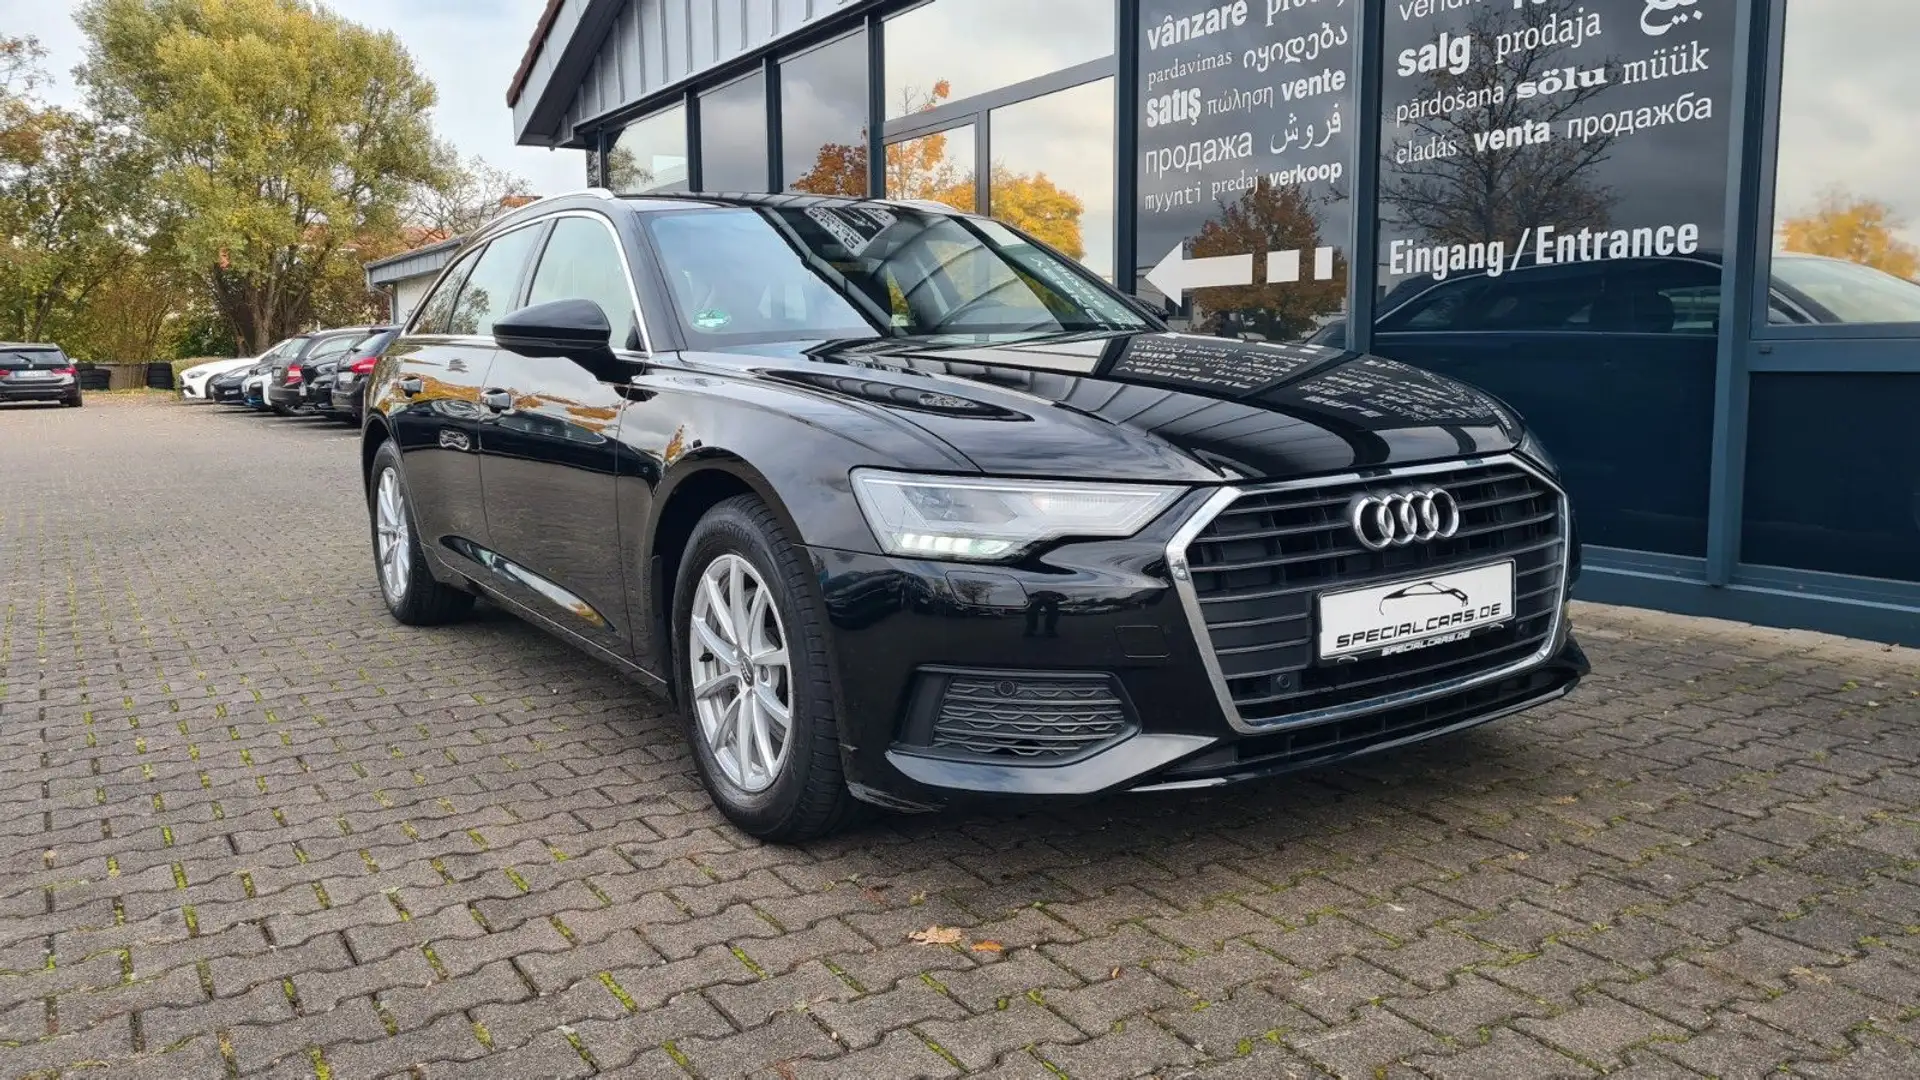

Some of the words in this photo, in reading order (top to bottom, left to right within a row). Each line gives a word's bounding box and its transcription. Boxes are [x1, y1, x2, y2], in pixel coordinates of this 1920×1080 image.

[1147, 0, 1248, 50] vânzare
[1243, 21, 1348, 73] იყიდება
[1397, 32, 1471, 76] salg
[1495, 7, 1602, 64] prodaja
[1147, 51, 1233, 90] pardavimas
[1281, 67, 1346, 101] vente
[1396, 86, 1505, 128] pārdošana
[1516, 66, 1608, 100] sölu
[1622, 40, 1710, 85] müük
[1146, 87, 1201, 127] satış
[1206, 85, 1274, 116] πώληση
[1567, 91, 1712, 144] продажба
[1269, 102, 1342, 155] فروش
[1395, 134, 1458, 165] eladás
[1473, 120, 1551, 152] venta
[1145, 131, 1252, 180] продажа
[1144, 181, 1201, 213] myynti
[1211, 168, 1260, 201] predaj
[1269, 162, 1343, 188] verkoop
[1389, 238, 1504, 281] Eingang
[1535, 222, 1699, 265] Entrance
[1336, 602, 1501, 648] SPECIALCARS.DE
